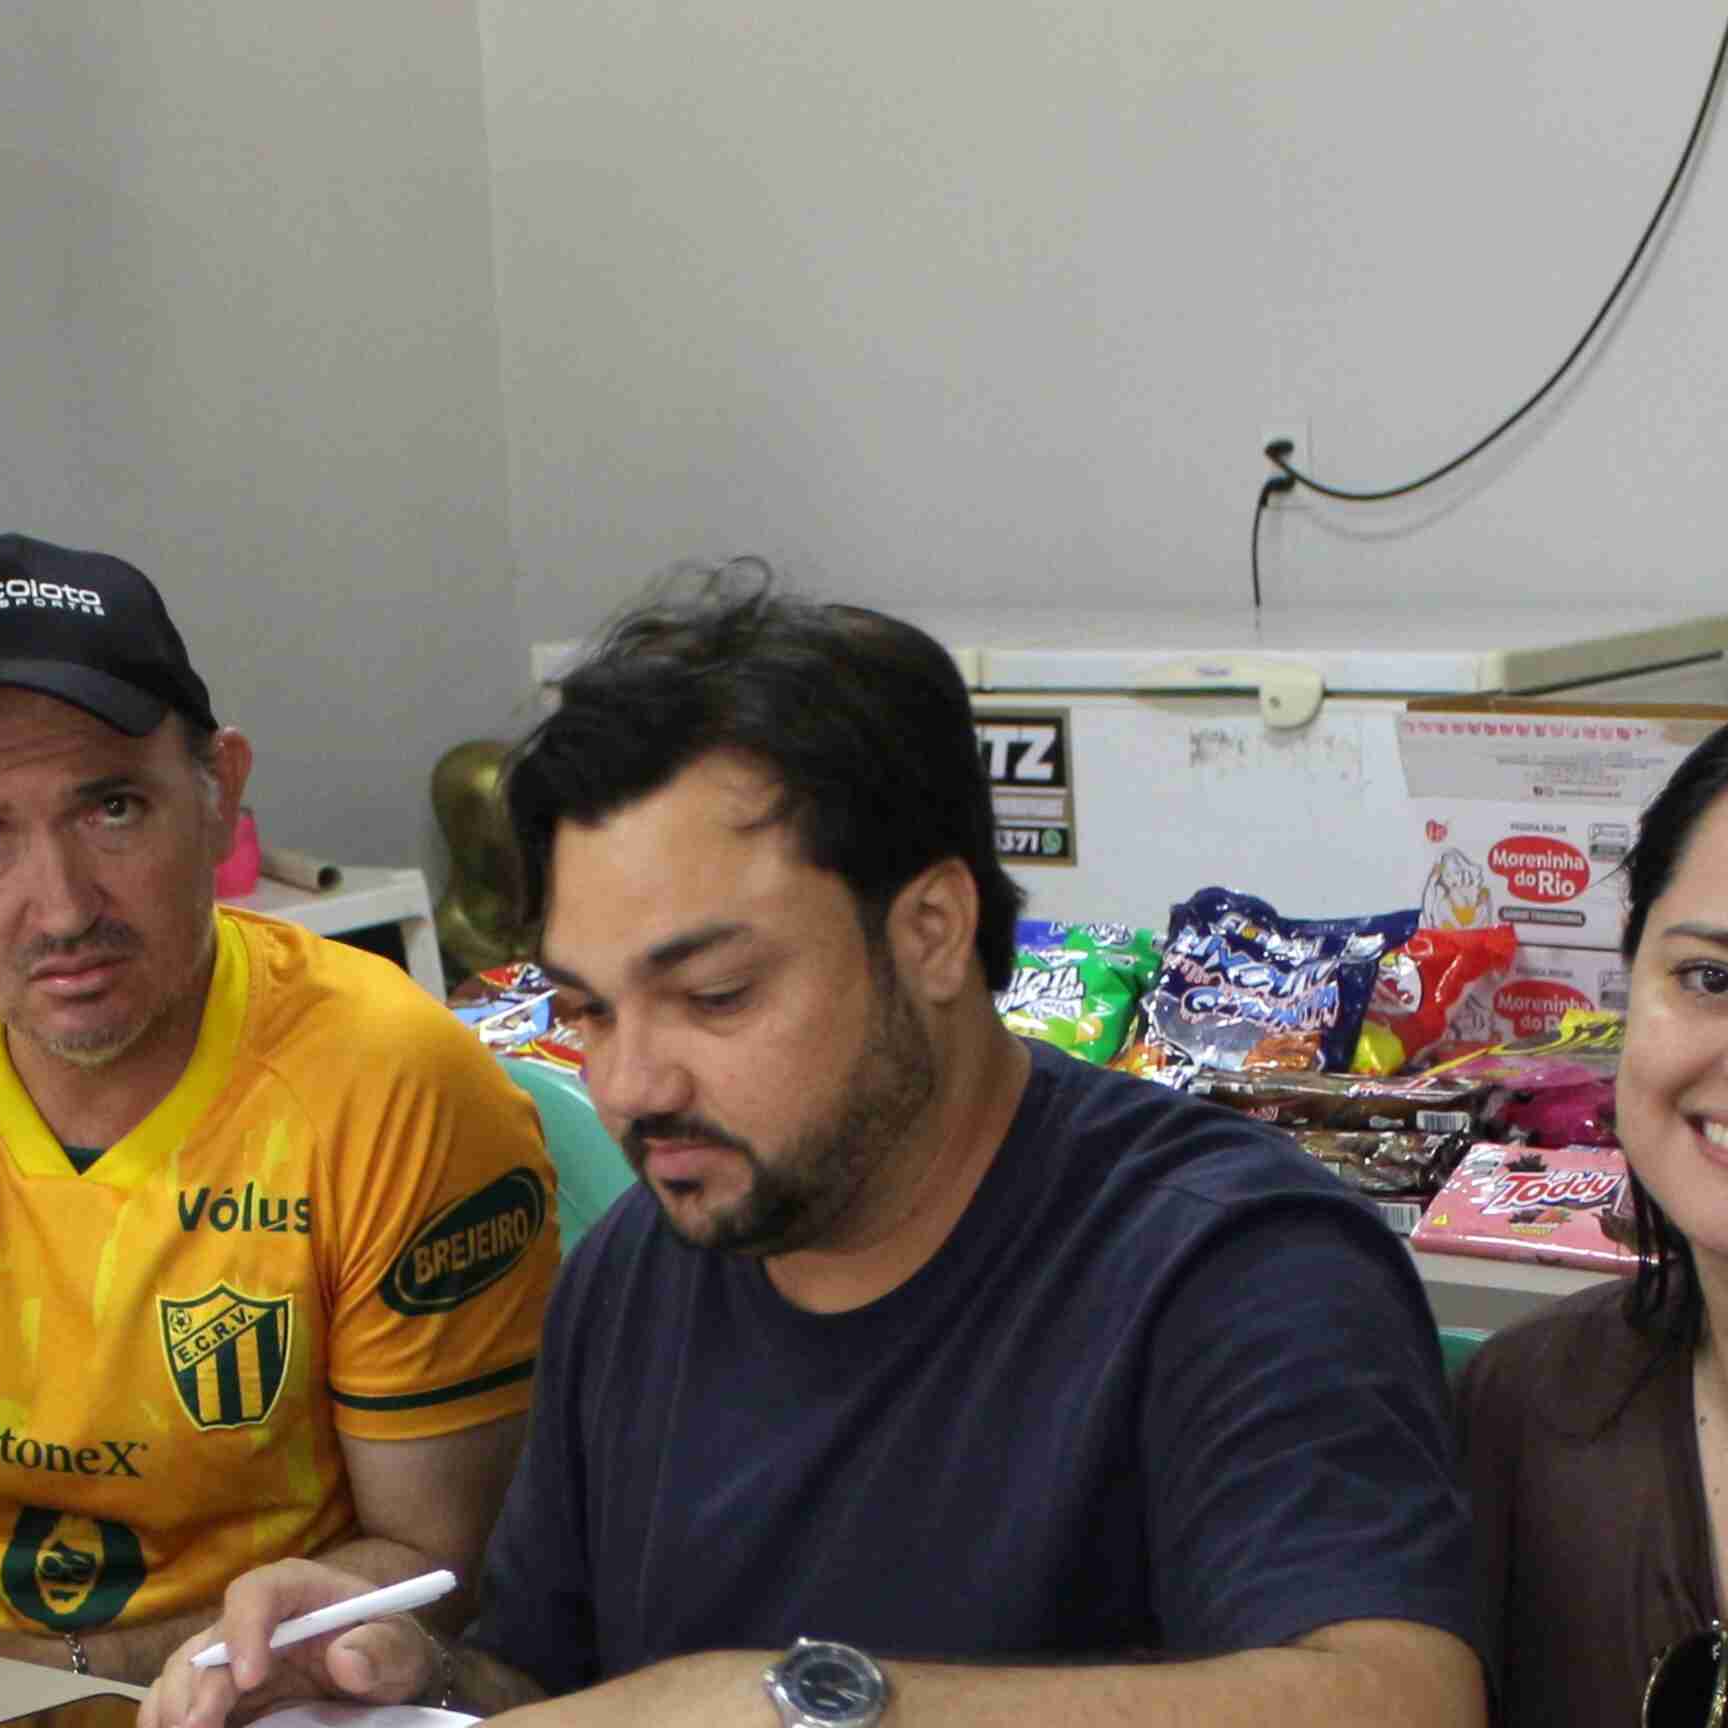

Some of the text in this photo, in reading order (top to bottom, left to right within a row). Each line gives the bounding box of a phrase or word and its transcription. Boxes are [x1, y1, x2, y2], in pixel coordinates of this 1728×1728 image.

[975, 725, 1057, 780] TZ
[1492, 850, 1585, 871] Moreninha
[1514, 867, 1576, 897] do Rio
[178, 1181, 312, 1235] Vólus
[1498, 1172, 1618, 1206] Toddy
[411, 1207, 529, 1286] BREJEIRO
[176, 1309, 254, 1365] E.C.R.V.
